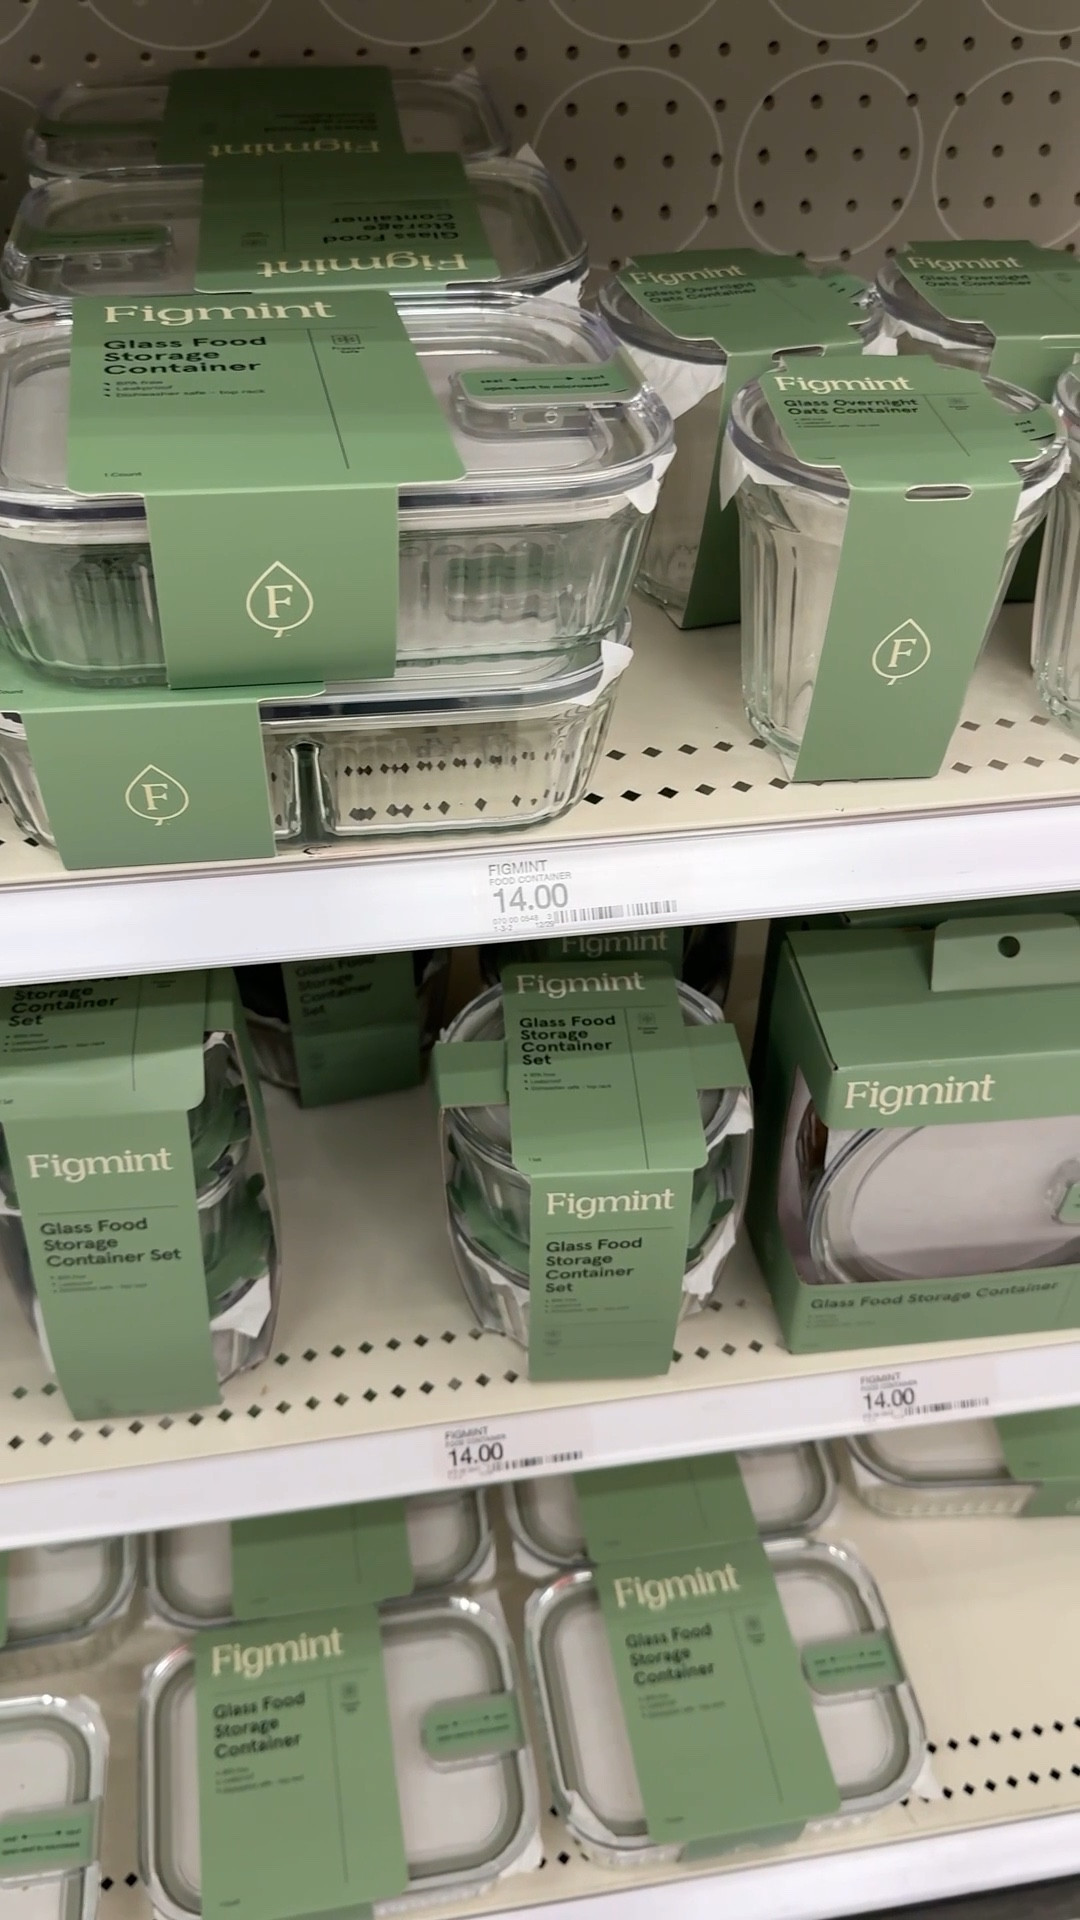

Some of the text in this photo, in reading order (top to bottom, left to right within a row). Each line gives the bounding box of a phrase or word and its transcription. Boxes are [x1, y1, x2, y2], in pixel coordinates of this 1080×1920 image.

[257, 250, 468, 277] Figmint
[907, 256, 1025, 272] Figmint
[629, 264, 748, 286] Figmint
[104, 301, 336, 326] Figmint
[103, 336, 267, 350] Glass Food
[104, 351, 220, 362] Storage
[104, 361, 261, 375] Container
[773, 376, 915, 394] Figmint
[783, 398, 920, 408] Glass Overnight
[787, 406, 919, 415] Oats Container
[265, 584, 293, 618] F
[887, 638, 917, 667] F
[141, 783, 168, 810] F
[488, 860, 548, 876] FIGMINT
[489, 872, 572, 886] FOOD CONTAINER
[493, 883, 568, 913] 14.00
[561, 930, 669, 958] Figmint
[14, 986, 94, 1001] Storage
[516, 971, 646, 999] Figmint
[11, 997, 119, 1013] Container
[8, 1014, 43, 1027] Set
[520, 1014, 615, 1028] Glass Food
[520, 1028, 588, 1041] Storage
[521, 1040, 613, 1053] Container
[522, 1054, 552, 1066] Set
[844, 1074, 996, 1115] Figmint
[27, 1147, 174, 1183] Figmint
[546, 1188, 675, 1220] Figmint
[40, 1217, 148, 1235] Glass Food
[44, 1238, 118, 1252] Storage
[546, 1237, 643, 1253] Glass Food
[46, 1248, 182, 1267] Container Set
[546, 1254, 613, 1267] Storage
[545, 1266, 635, 1281] Container
[545, 1282, 573, 1293] Set
[810, 1281, 1059, 1310] Glass Food Storage Container
[863, 1387, 915, 1410] 14.00
[448, 1442, 504, 1466] 14.00
[613, 1563, 741, 1611] Figmint
[625, 1622, 713, 1648] Glass Food
[211, 1627, 345, 1680] Figmint
[629, 1647, 691, 1667] Storage
[633, 1662, 714, 1686] Container
[212, 1690, 306, 1719] Glass Food
[214, 1718, 279, 1739] Storage
[214, 1734, 301, 1759] Container
